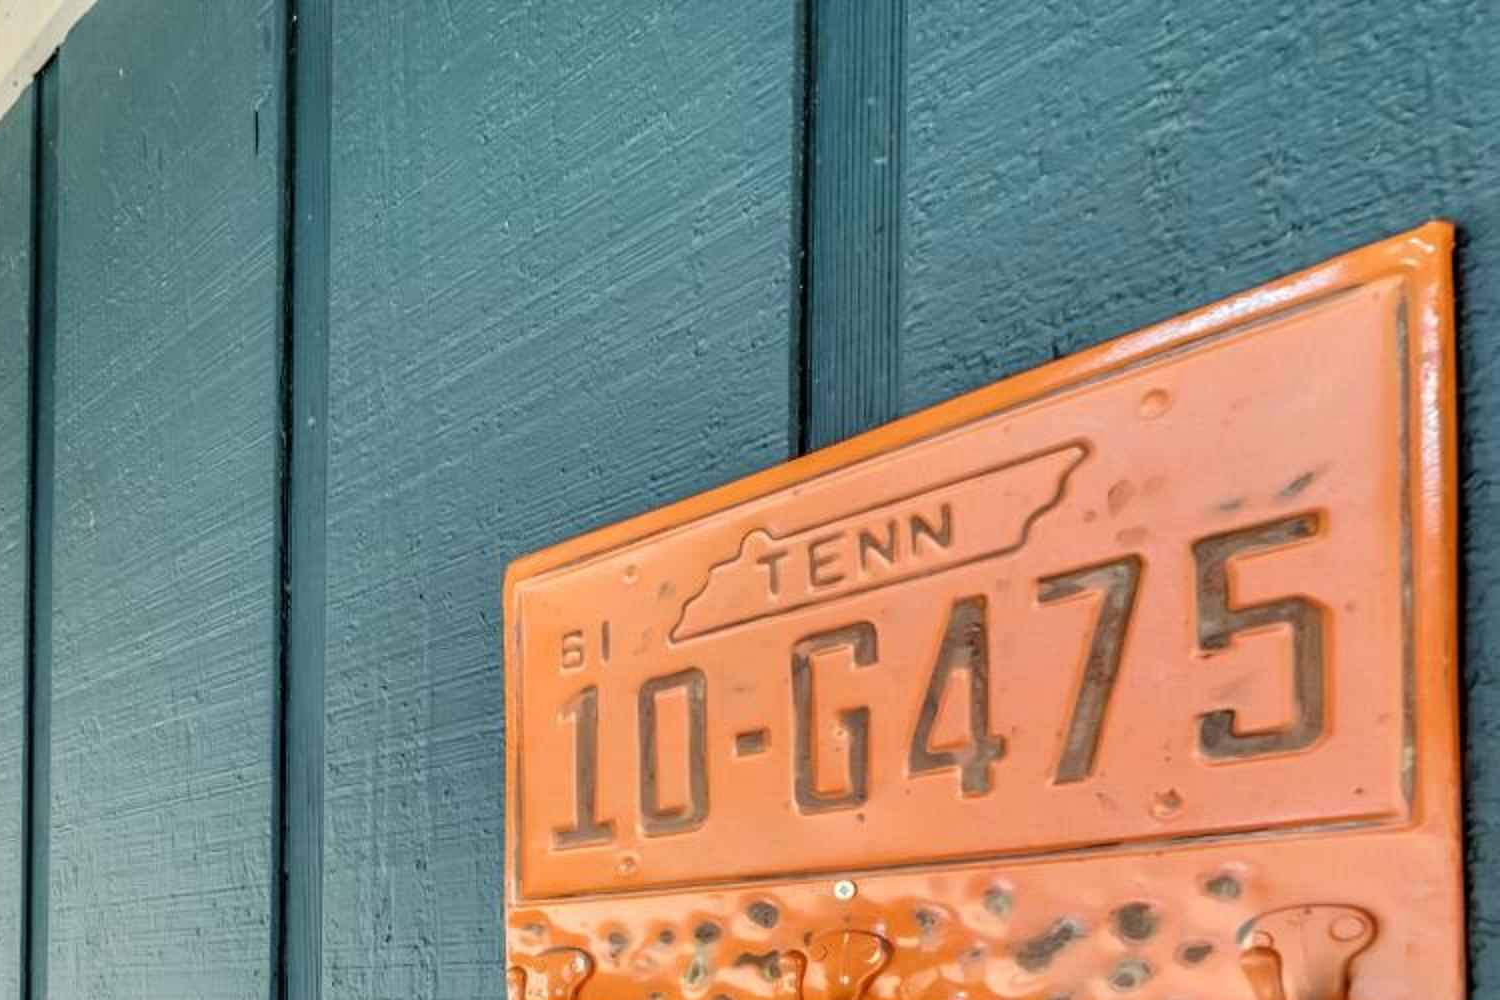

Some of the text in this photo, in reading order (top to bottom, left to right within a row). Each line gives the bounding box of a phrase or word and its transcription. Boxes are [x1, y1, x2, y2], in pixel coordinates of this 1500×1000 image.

[756, 503, 953, 595] TENN
[552, 509, 1328, 848] 10-G475
[560, 620, 610, 669] 61
